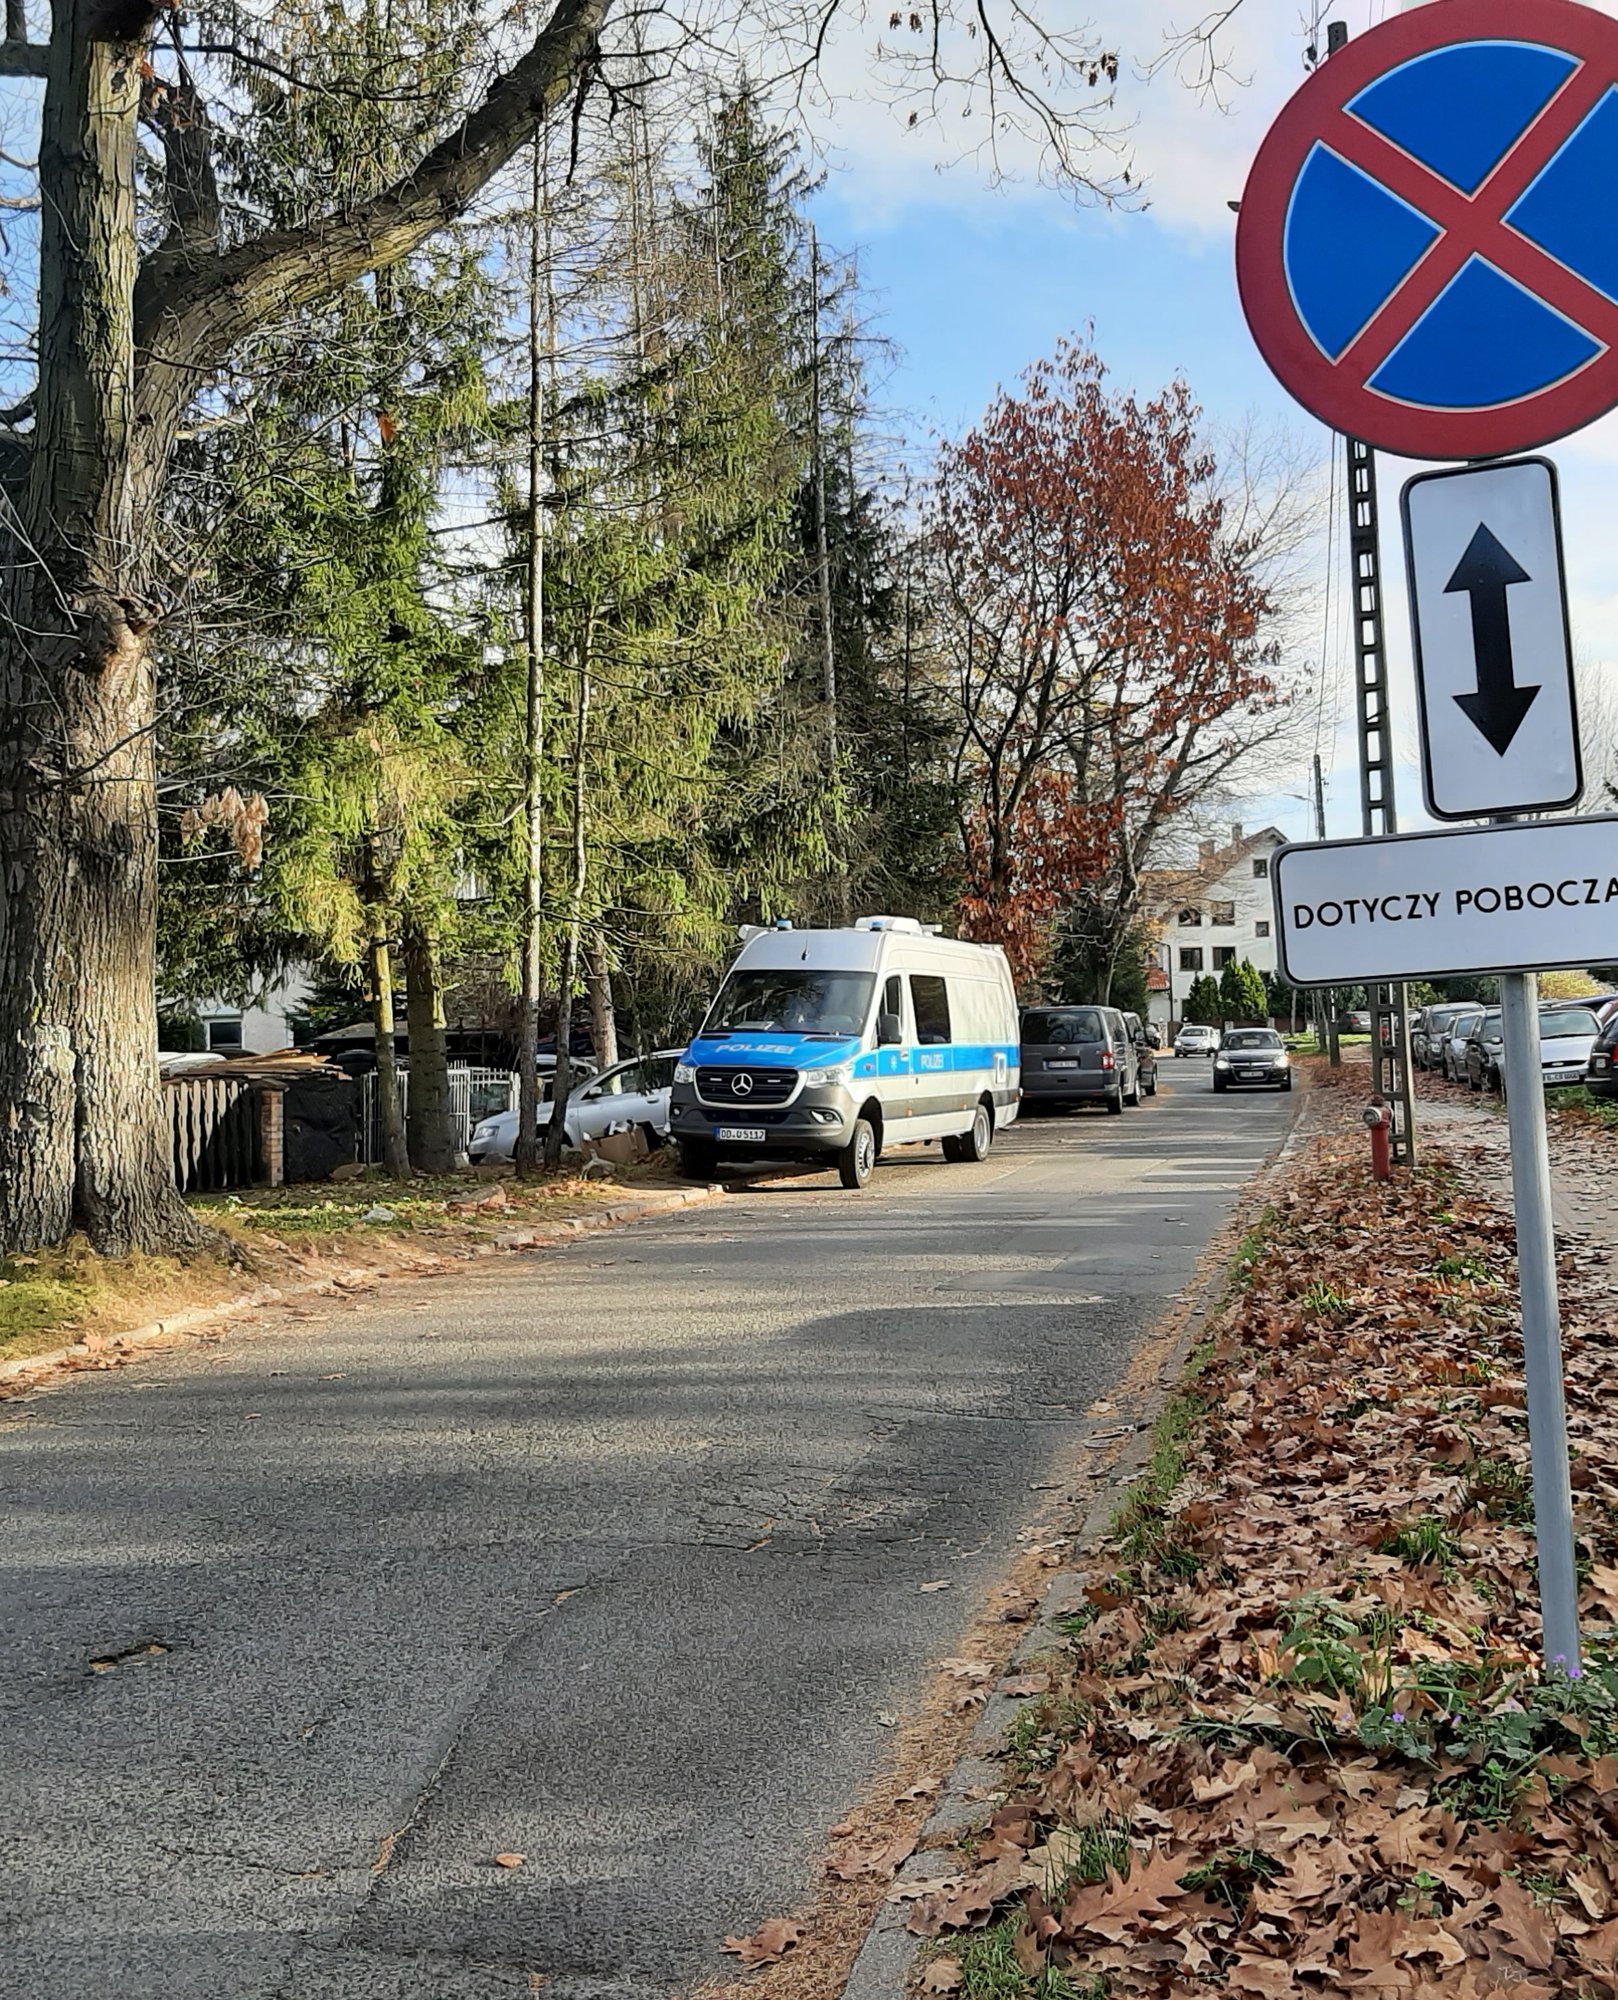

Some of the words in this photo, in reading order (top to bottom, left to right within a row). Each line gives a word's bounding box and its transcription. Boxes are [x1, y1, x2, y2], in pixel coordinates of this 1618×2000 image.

[1293, 892, 1441, 929] DOTYCZY
[715, 1043, 796, 1055] POLIZEI
[920, 1053, 945, 1070] POLIZEI
